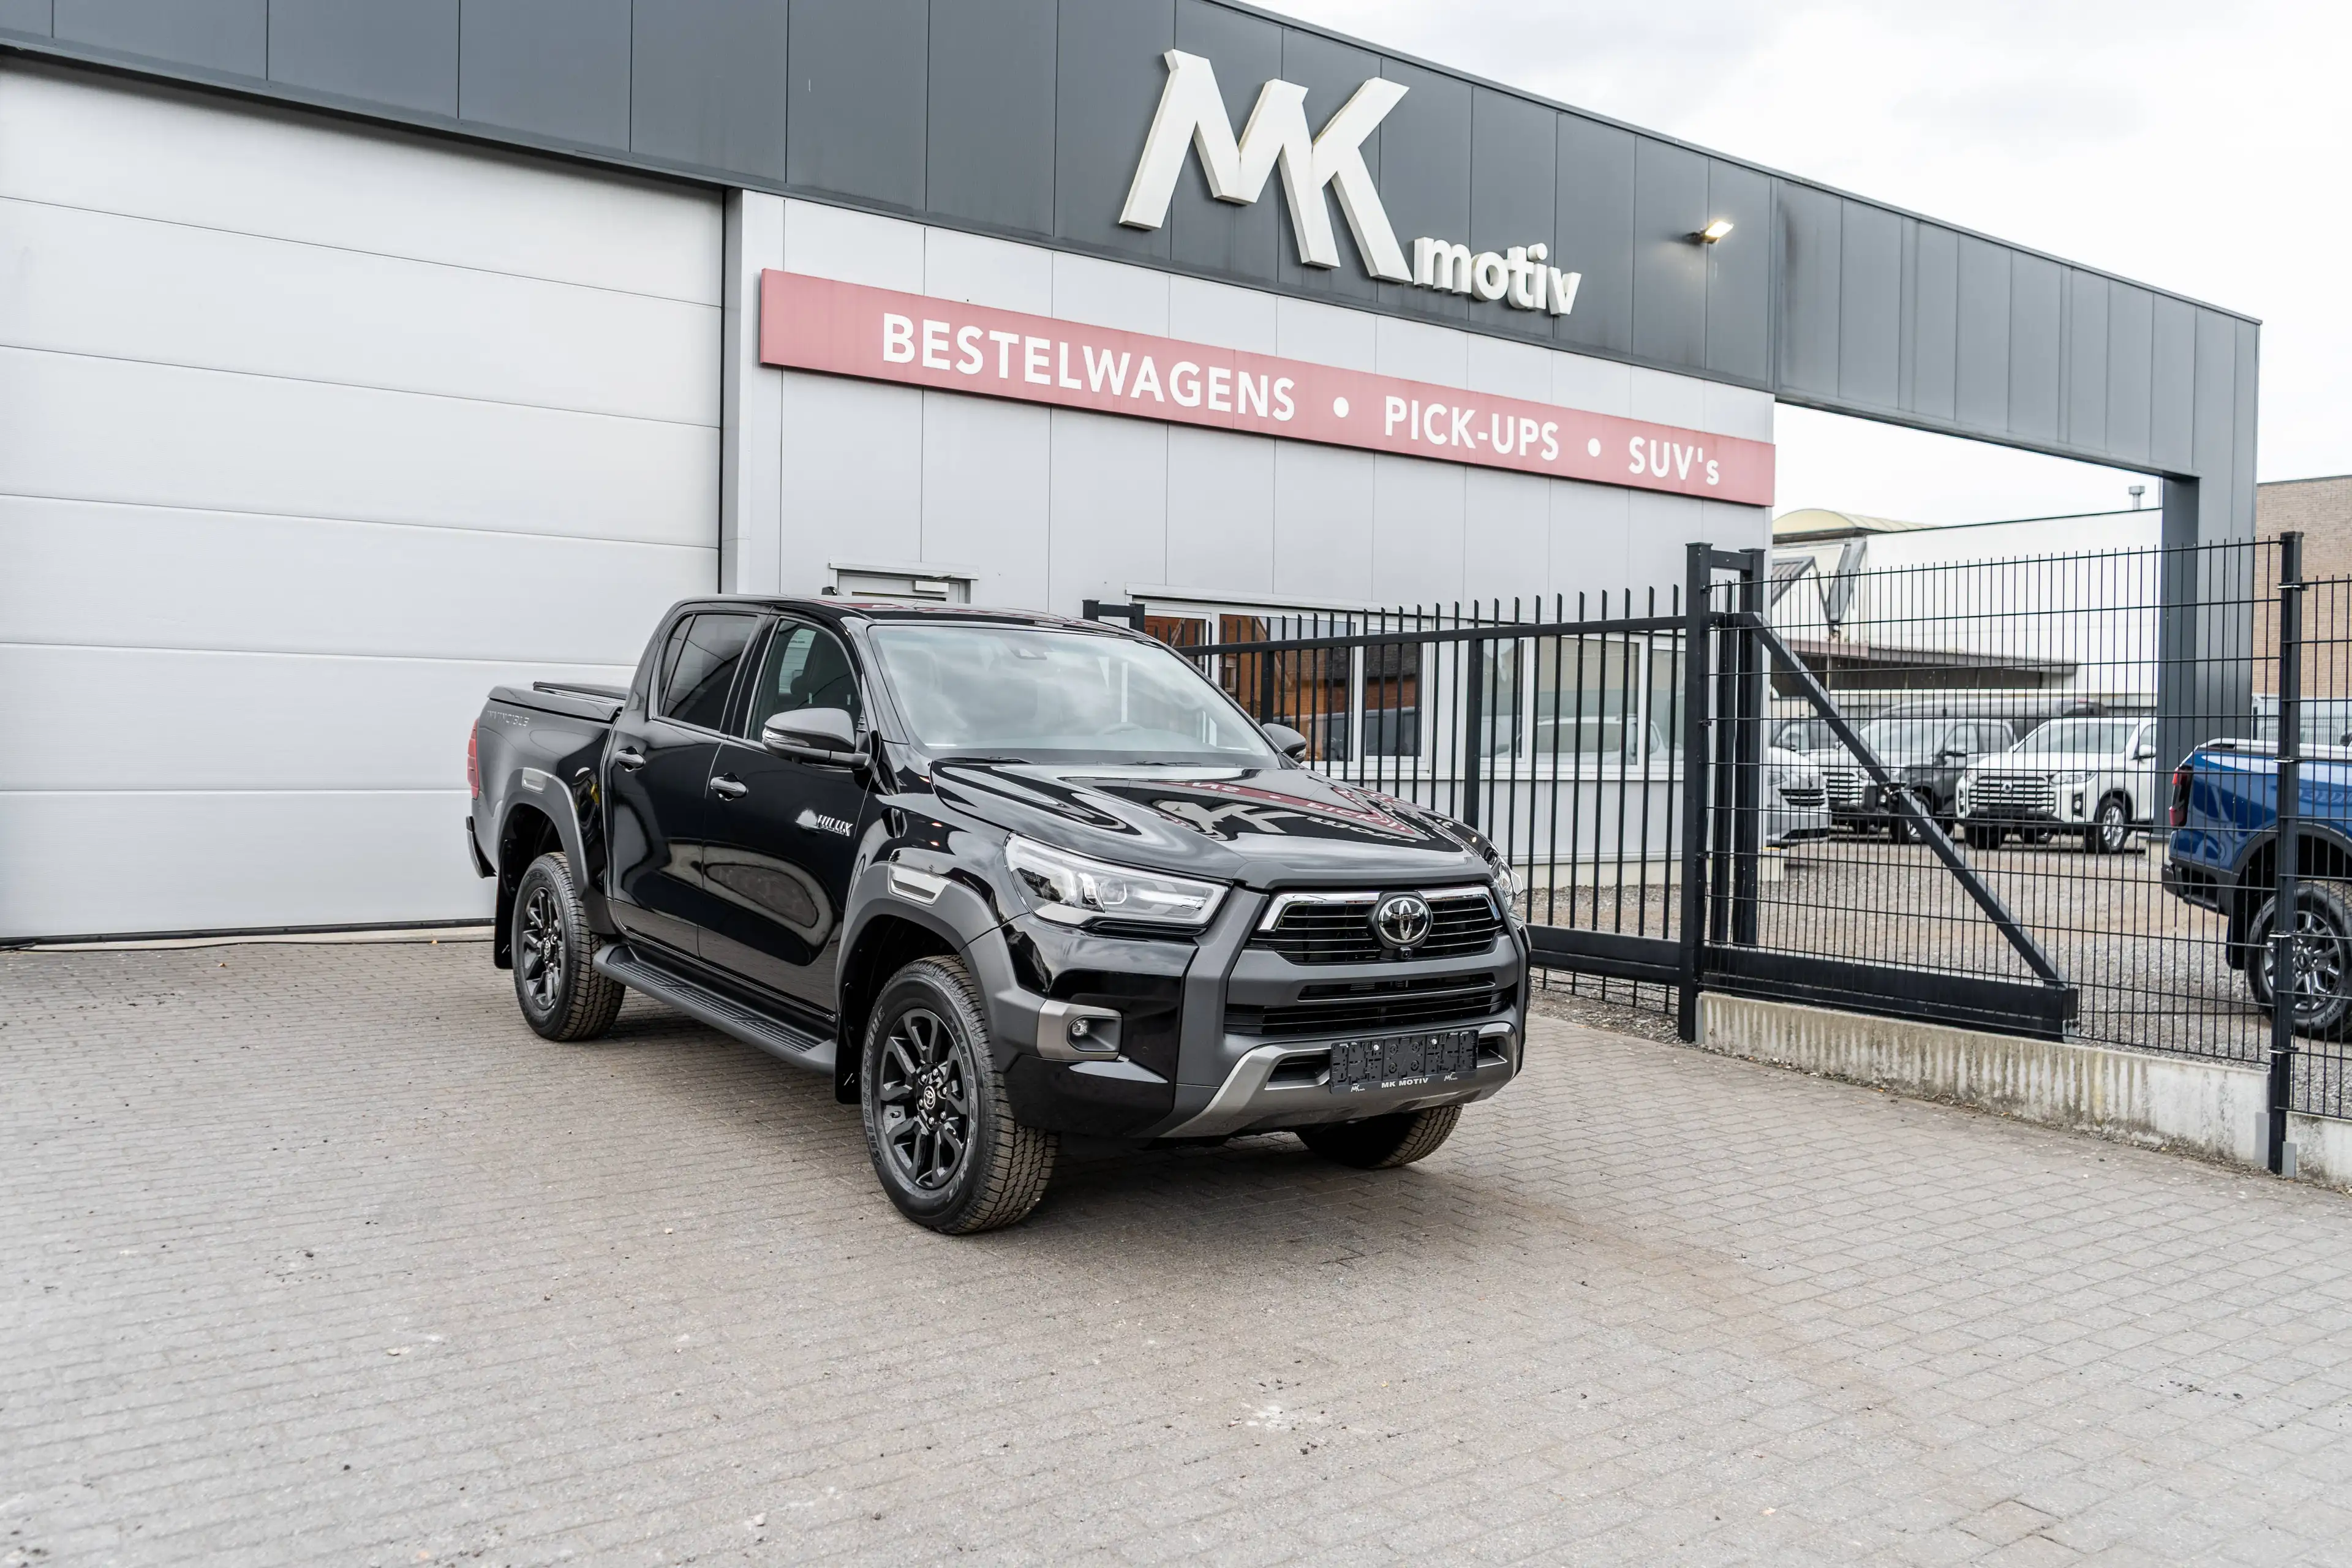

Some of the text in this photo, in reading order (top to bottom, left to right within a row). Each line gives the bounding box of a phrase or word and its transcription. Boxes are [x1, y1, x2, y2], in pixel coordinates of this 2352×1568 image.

[1118, 48, 1581, 316] MK motiv
[883, 312, 1720, 486] BESTELWAGENS PICK-UPS SUV's
[817, 814, 853, 837] HILUX
[1398, 1077, 1429, 1087] MOTIV
